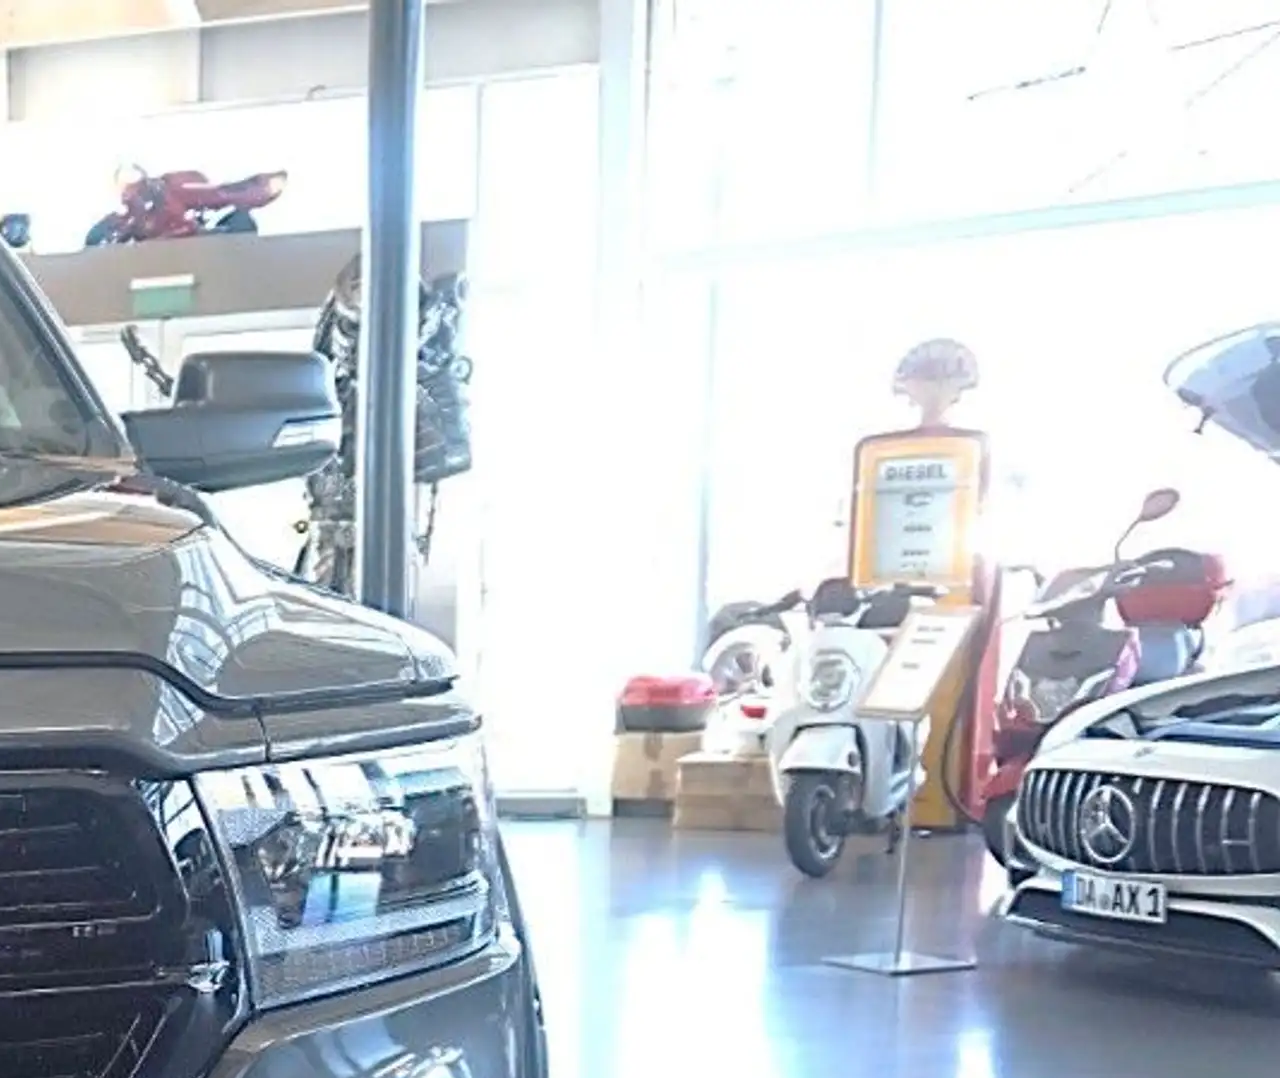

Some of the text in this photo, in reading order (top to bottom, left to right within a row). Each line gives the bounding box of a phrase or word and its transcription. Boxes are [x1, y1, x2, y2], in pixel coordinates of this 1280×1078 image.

[884, 463, 948, 481] DIESEL
[1111, 882, 1141, 915] AX
[1146, 887, 1161, 917] 1
